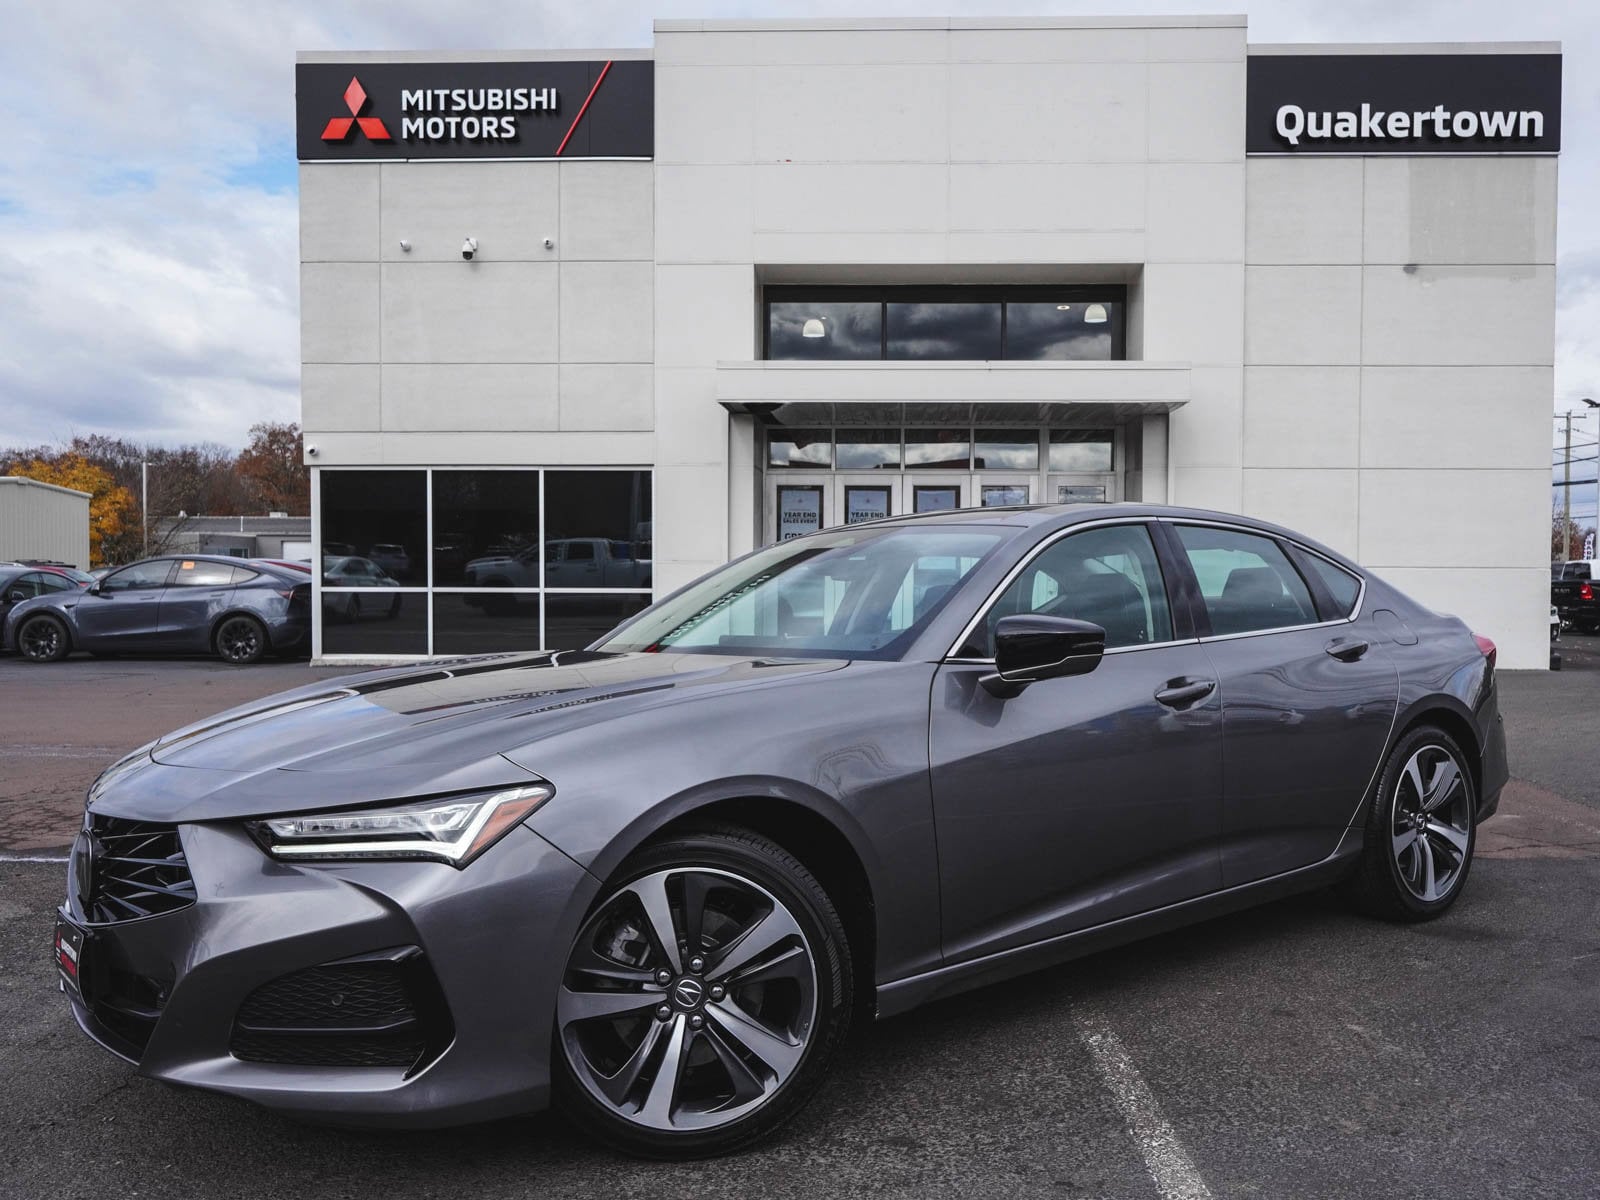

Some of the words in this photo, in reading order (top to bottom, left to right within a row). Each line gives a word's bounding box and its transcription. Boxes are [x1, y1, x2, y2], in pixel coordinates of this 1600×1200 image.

[401, 87, 557, 112] MITSUBISHI
[401, 116, 516, 140] MOTORS
[1275, 103, 1544, 145] Quakertown
